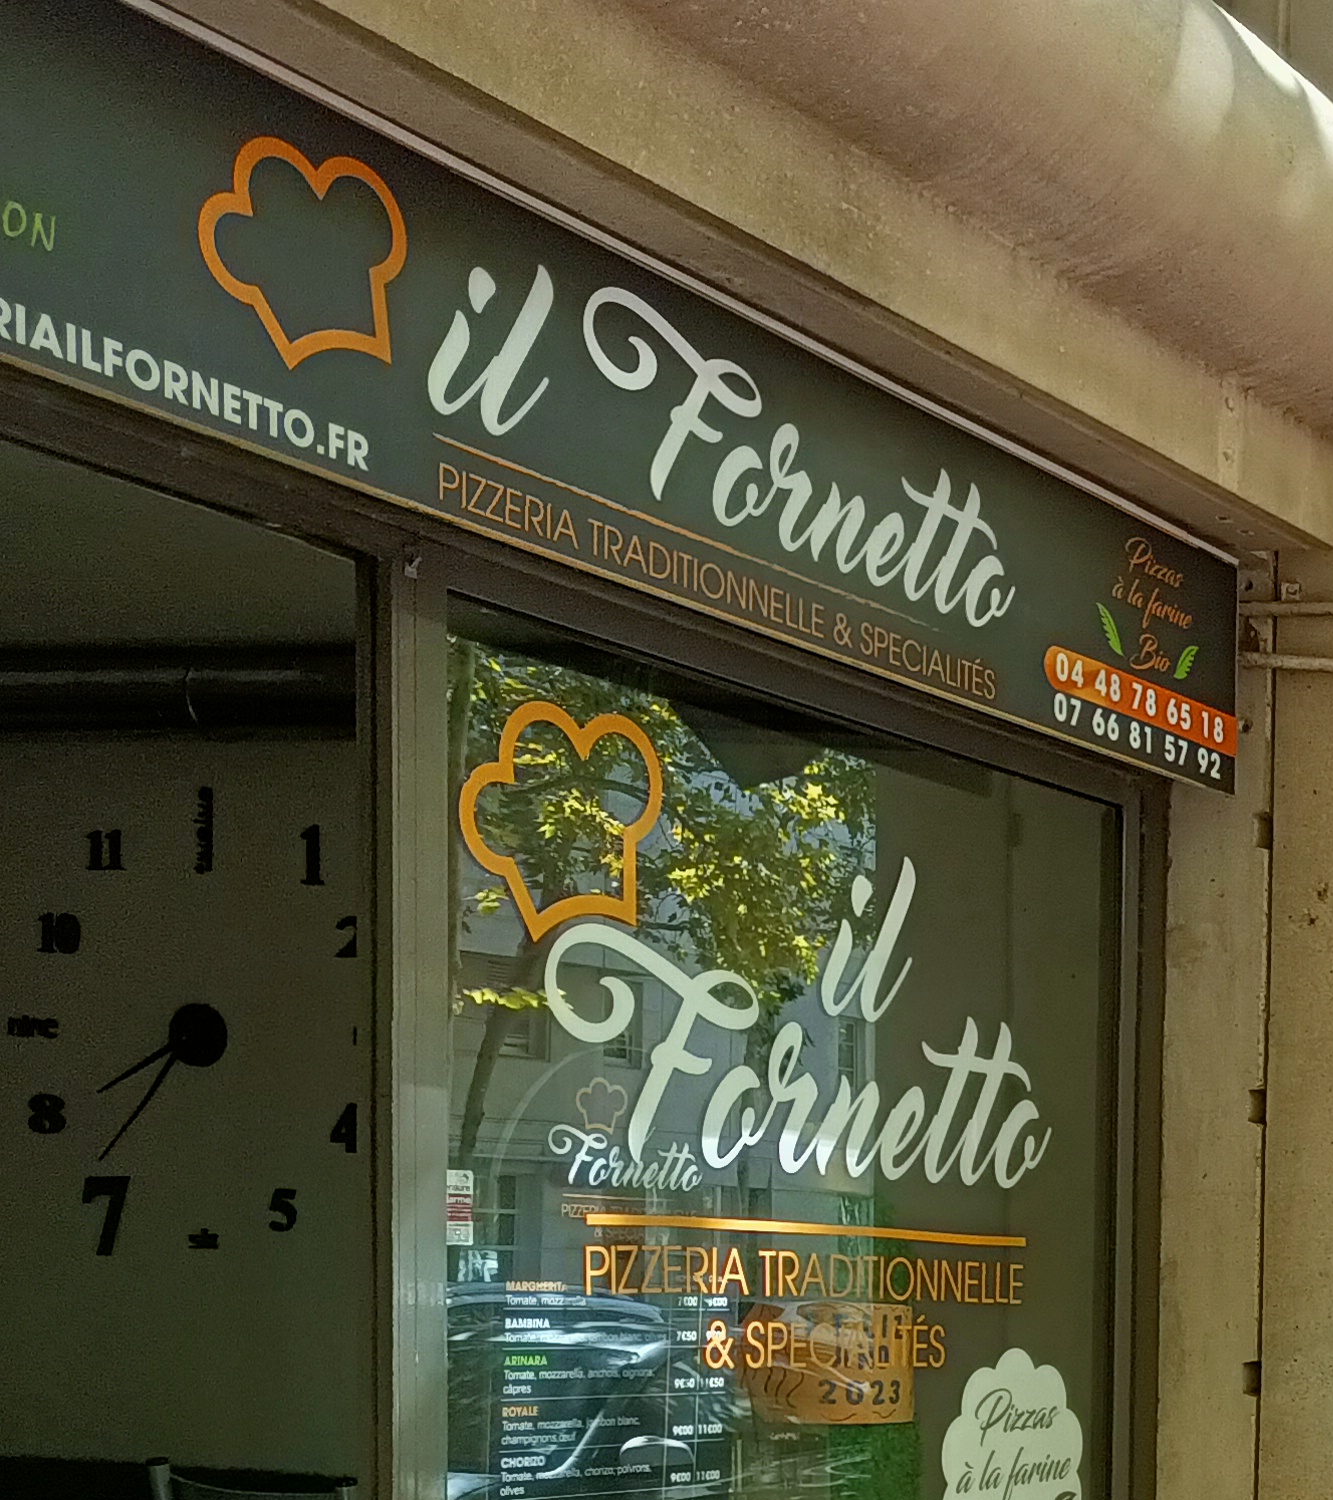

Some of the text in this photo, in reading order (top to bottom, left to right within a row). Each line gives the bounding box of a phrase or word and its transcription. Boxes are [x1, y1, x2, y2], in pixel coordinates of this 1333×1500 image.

[427, 264, 1016, 628] il Fornetto
[438, 462, 996, 701] PIZZERIA TRADITIONNELLE & SPECIALITÉS
[1125, 537, 1185, 588] Pizzas
[1111, 576, 1194, 629] à la farine
[1129, 633, 1172, 672] Bio
[1055, 653, 1224, 744] 04 48 78 65 18
[1053, 692, 1222, 780] 07 66 81 57 92
[85, 829, 127, 871] 11
[300, 824, 325, 886] 1
[36, 912, 81, 955] 10
[821, 856, 917, 1024] il
[544, 922, 1052, 1189] Fornetto
[27, 1093, 67, 1135] 8
[329, 1102, 358, 1154] 4
[547, 1123, 703, 1192] Fornetto
[82, 1176, 131, 1256] 7
[268, 1188, 298, 1232] 5
[584, 1244, 1024, 1306] PIZZERIA TRADITIONNELLE
[704, 1318, 735, 1371] &
[745, 1315, 946, 1371] SPECIALITÉS
[818, 1378, 901, 1406] 2023
[975, 1388, 1060, 1447] Pizzas
[955, 1461, 975, 1494] à
[978, 1450, 1002, 1491] la
